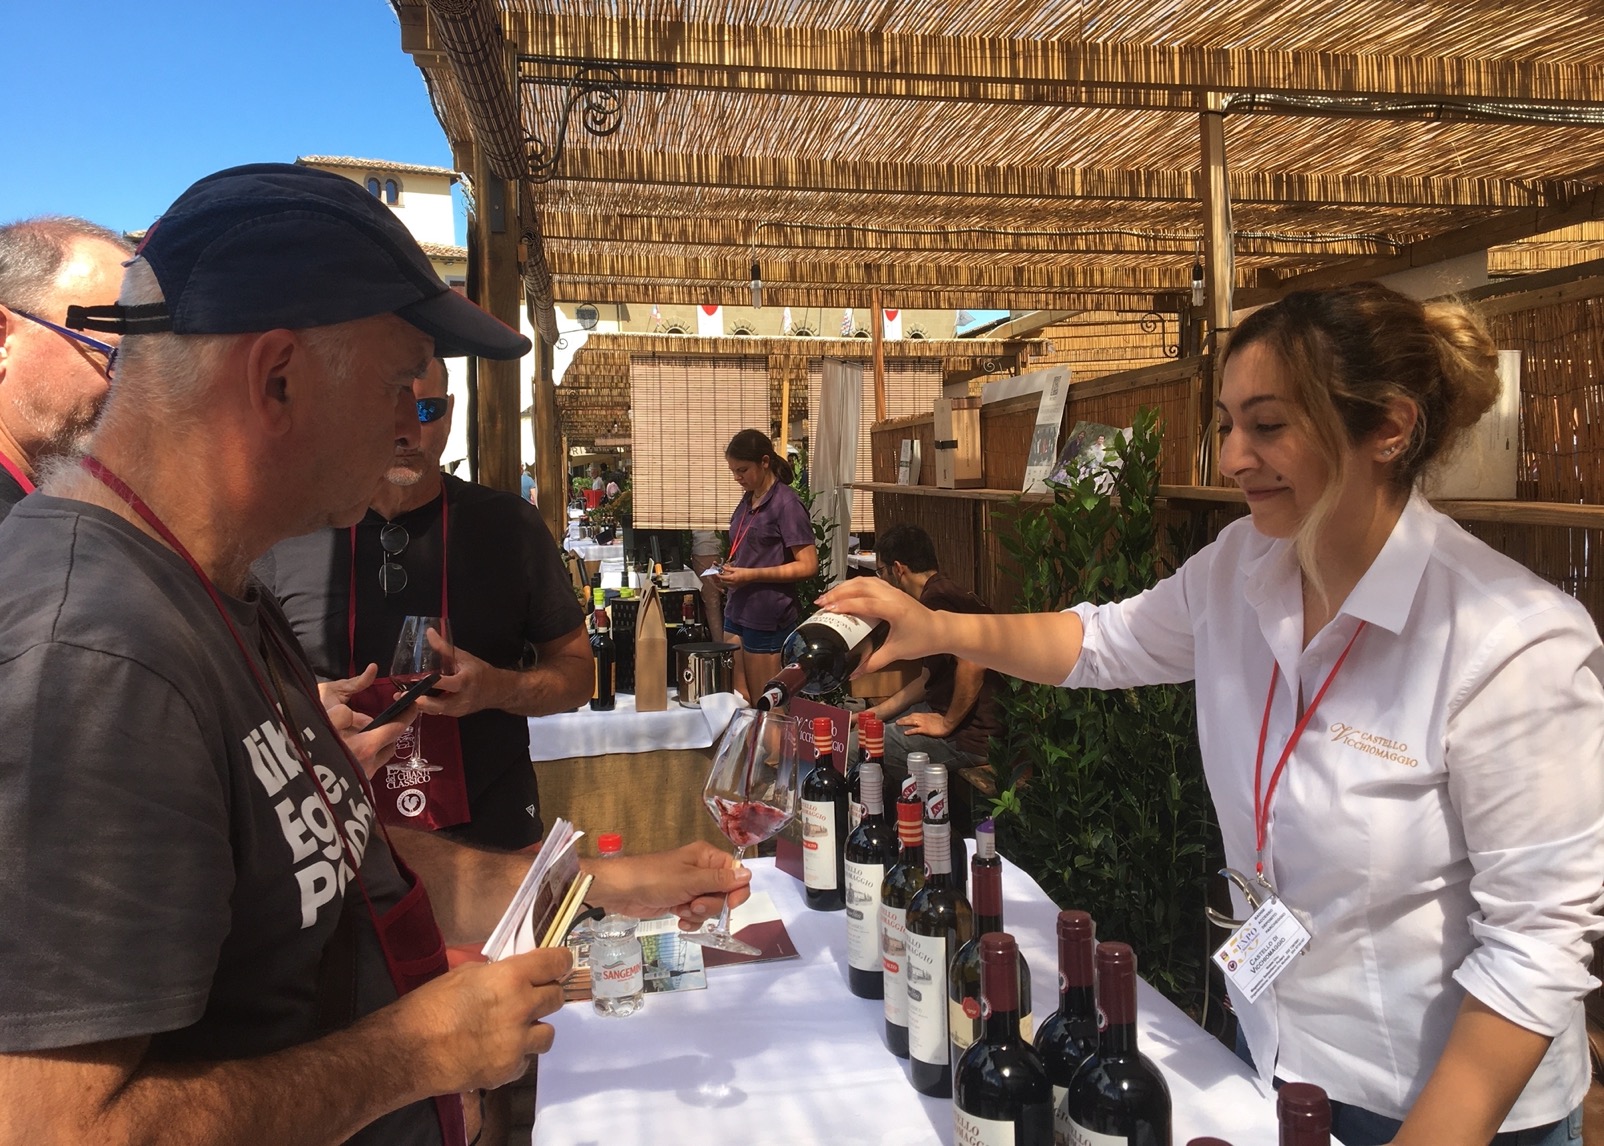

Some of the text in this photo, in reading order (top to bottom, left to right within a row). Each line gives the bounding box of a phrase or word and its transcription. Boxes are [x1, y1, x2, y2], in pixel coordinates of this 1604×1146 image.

[1330, 722, 1419, 768] VICCHIOMAGGIO
[1361, 732, 1408, 752] CASTELLO
[386, 775, 431, 790] CLASSICO
[397, 769, 431, 781] CHIANTI
[1236, 927, 1258, 951] EXPO
[1249, 941, 1274, 966] CASTELLO
[1272, 935, 1279, 943] DI
[1250, 937, 1286, 974] VICCHIOMAGGIO
